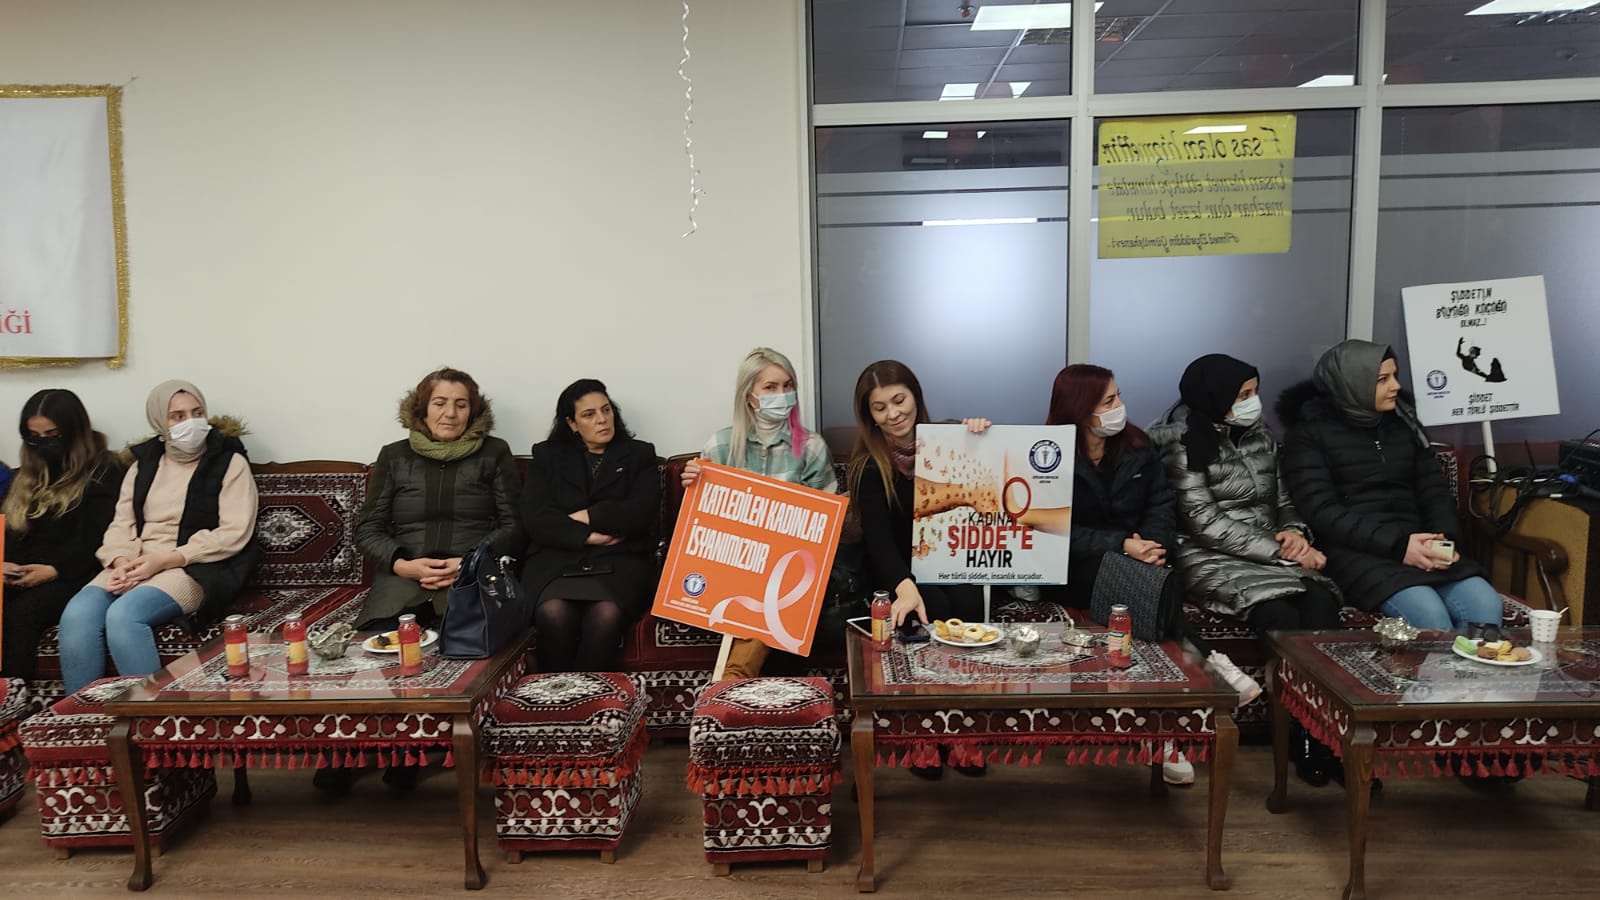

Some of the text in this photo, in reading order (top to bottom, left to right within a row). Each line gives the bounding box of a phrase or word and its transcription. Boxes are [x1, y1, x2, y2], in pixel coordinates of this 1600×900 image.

[697, 482, 829, 545] KATLEDİLEN KADINLAR
[968, 511, 1014, 526] KADINA
[685, 517, 771, 575] İSYANIMIZDIR
[966, 550, 1013, 568] HAYIR
[938, 572, 950, 580] Her
